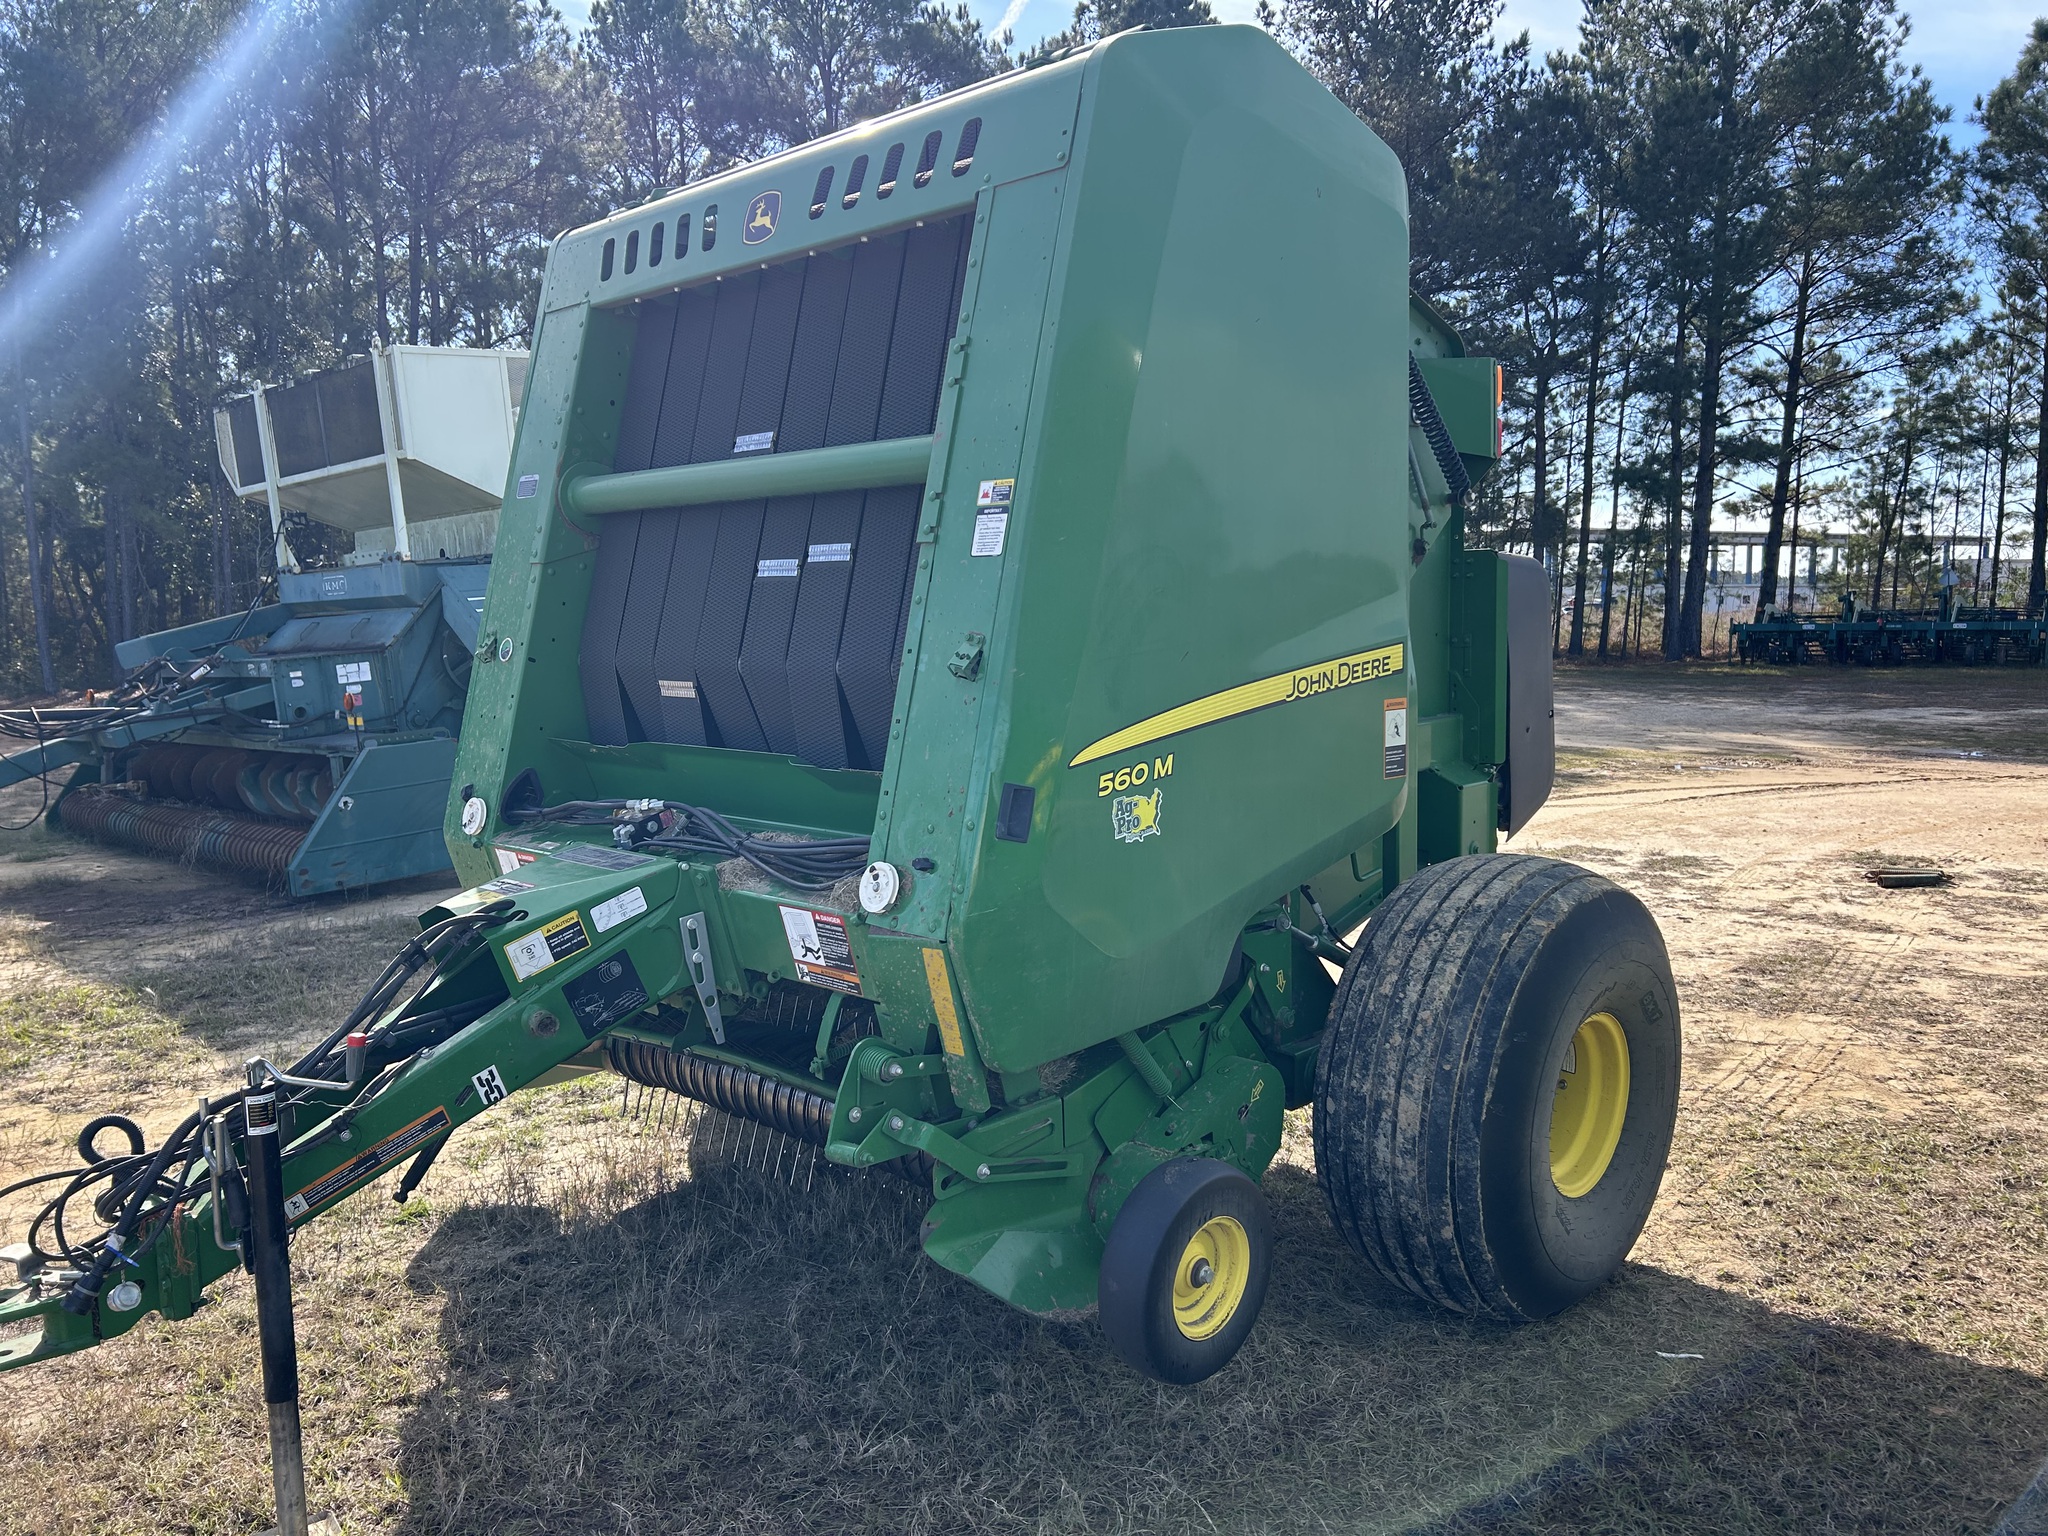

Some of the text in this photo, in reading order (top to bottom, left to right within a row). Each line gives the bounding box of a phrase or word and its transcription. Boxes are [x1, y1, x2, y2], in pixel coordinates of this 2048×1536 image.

[325, 580, 345, 591] KMC
[1286, 655, 1392, 699] JOHN DEERE
[1098, 753, 1174, 797] 560 M
[1115, 799, 1138, 818] Ag-
[1116, 815, 1141, 835] Pro
[551, 915, 575, 931] CAUTION
[820, 914, 841, 924] DANGER
[359, 1138, 390, 1160] WARNING
